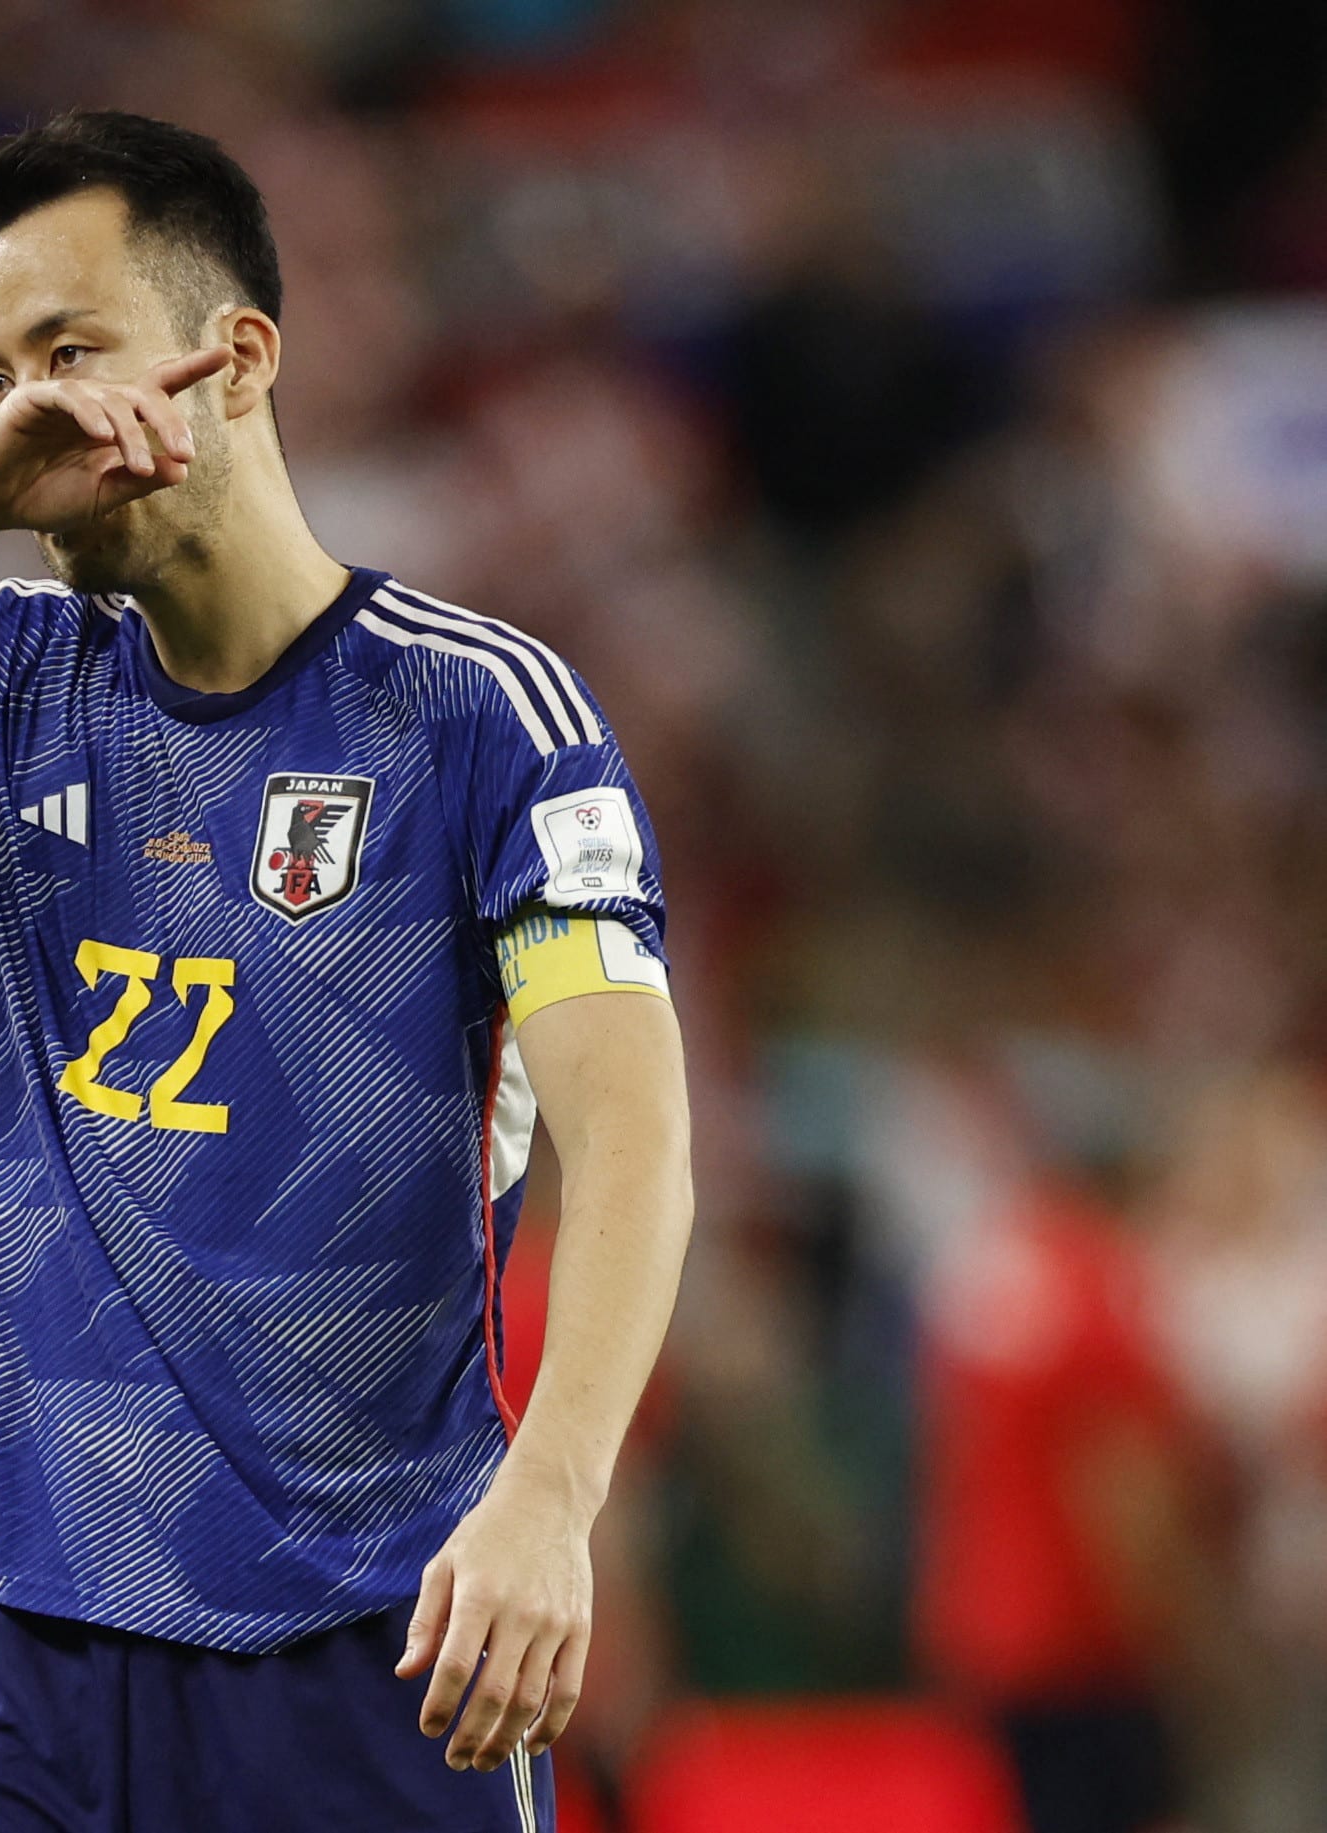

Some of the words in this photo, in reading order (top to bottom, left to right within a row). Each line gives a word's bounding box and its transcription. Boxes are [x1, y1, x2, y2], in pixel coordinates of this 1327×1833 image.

[285, 778, 344, 793] JAPAN
[578, 848, 614, 863] UNITES
[273, 872, 322, 895] JFA
[497, 911, 570, 967] ATION
[55, 938, 235, 1134] 22
